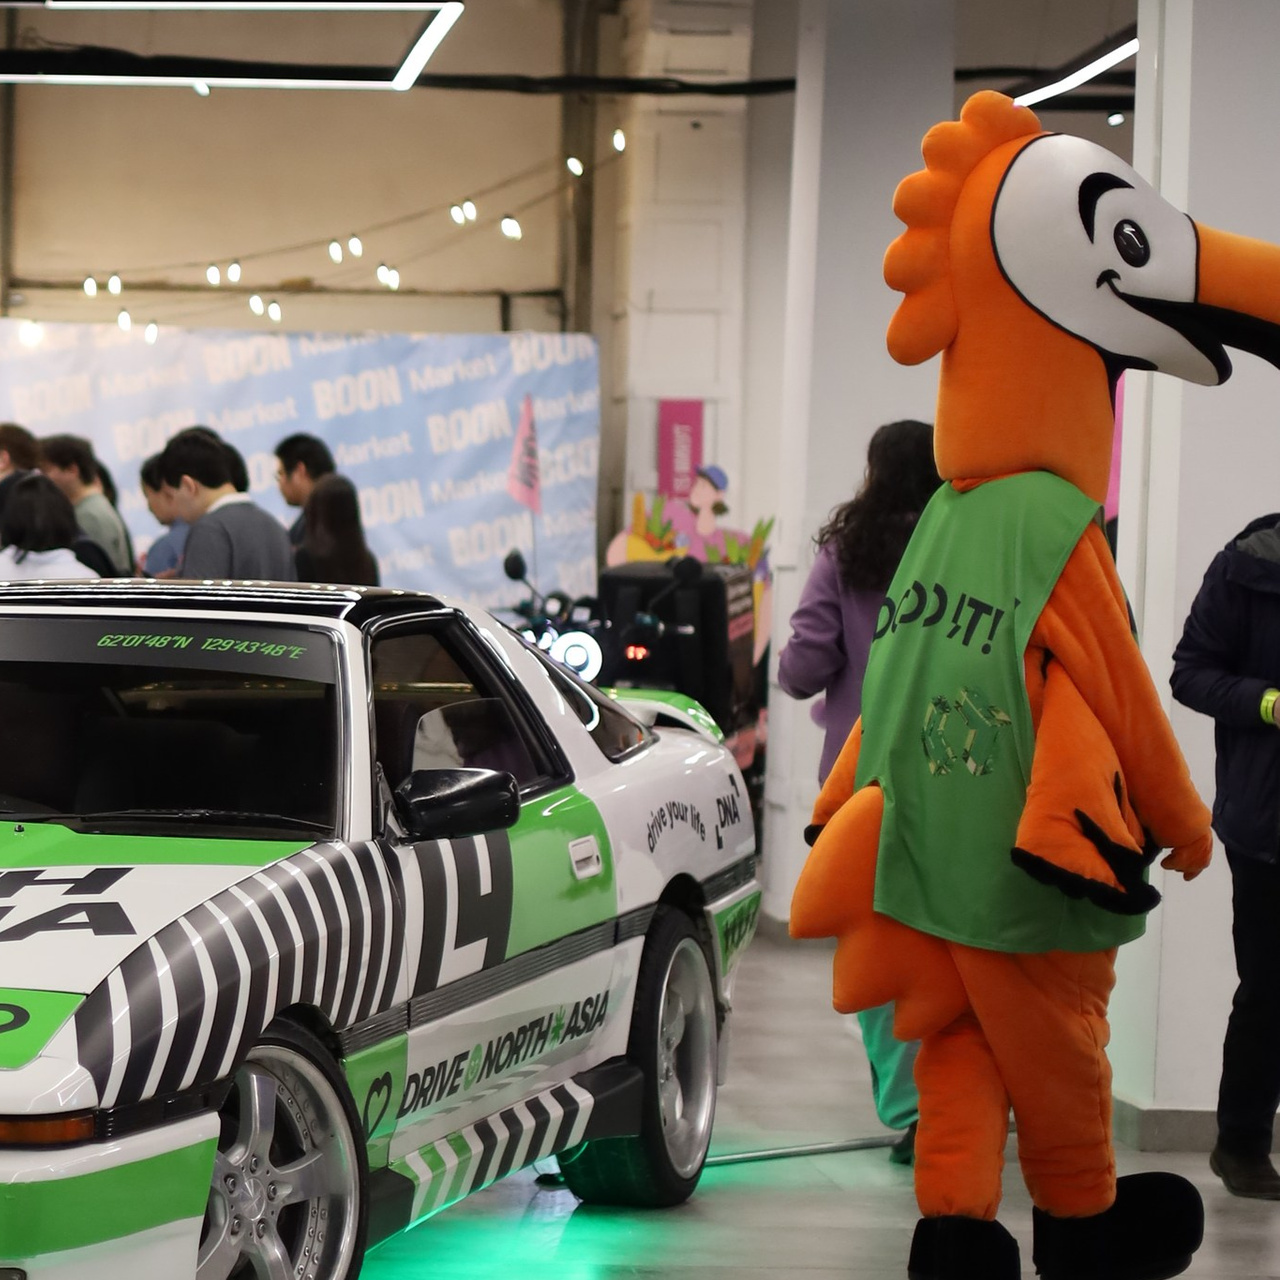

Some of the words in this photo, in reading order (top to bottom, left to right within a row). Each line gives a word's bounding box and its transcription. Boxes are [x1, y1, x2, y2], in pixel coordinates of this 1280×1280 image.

[204, 334, 293, 384] BOON
[312, 365, 403, 420] BOON
[408, 354, 498, 393] Market
[426, 398, 514, 455] BOON
[360, 478, 426, 528] OON
[448, 515, 533, 567] BOON
[647, 807, 667, 853] drive
[666, 801, 688, 829] your
[690, 803, 706, 841] life
[716, 793, 740, 829] DNA
[396, 1050, 470, 1119] DRIVE
[476, 1012, 554, 1083] NORTH
[559, 990, 609, 1045] ASIA
